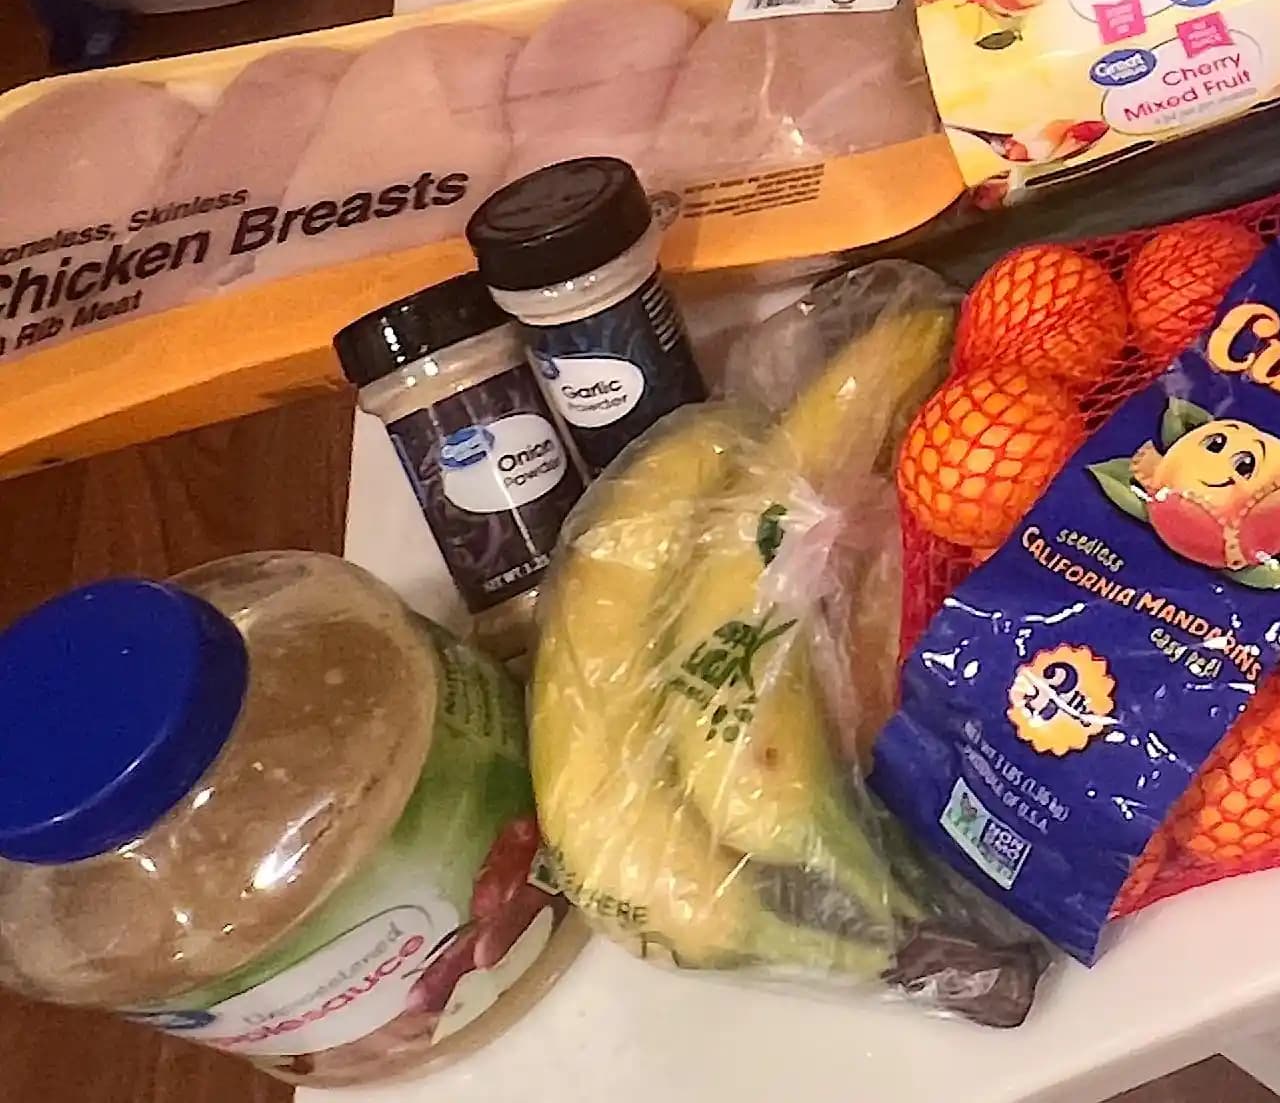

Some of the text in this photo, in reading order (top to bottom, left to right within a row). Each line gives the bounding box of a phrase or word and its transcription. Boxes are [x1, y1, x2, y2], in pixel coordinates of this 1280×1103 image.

[1162, 52, 1241, 87] Cherry
[1124, 69, 1252, 122] Mixed Fruit
[0, 187, 249, 266] oneless, Skinless
[230, 171, 469, 256] Breasts
[15, 289, 144, 349] Rib Meat
[561, 379, 623, 399] Garlic
[498, 438, 553, 473] Onion
[1056, 527, 1126, 573] seedless
[1021, 525, 1263, 681] CALIFORNIA MANDARINS
[1150, 628, 1184, 664] easy
